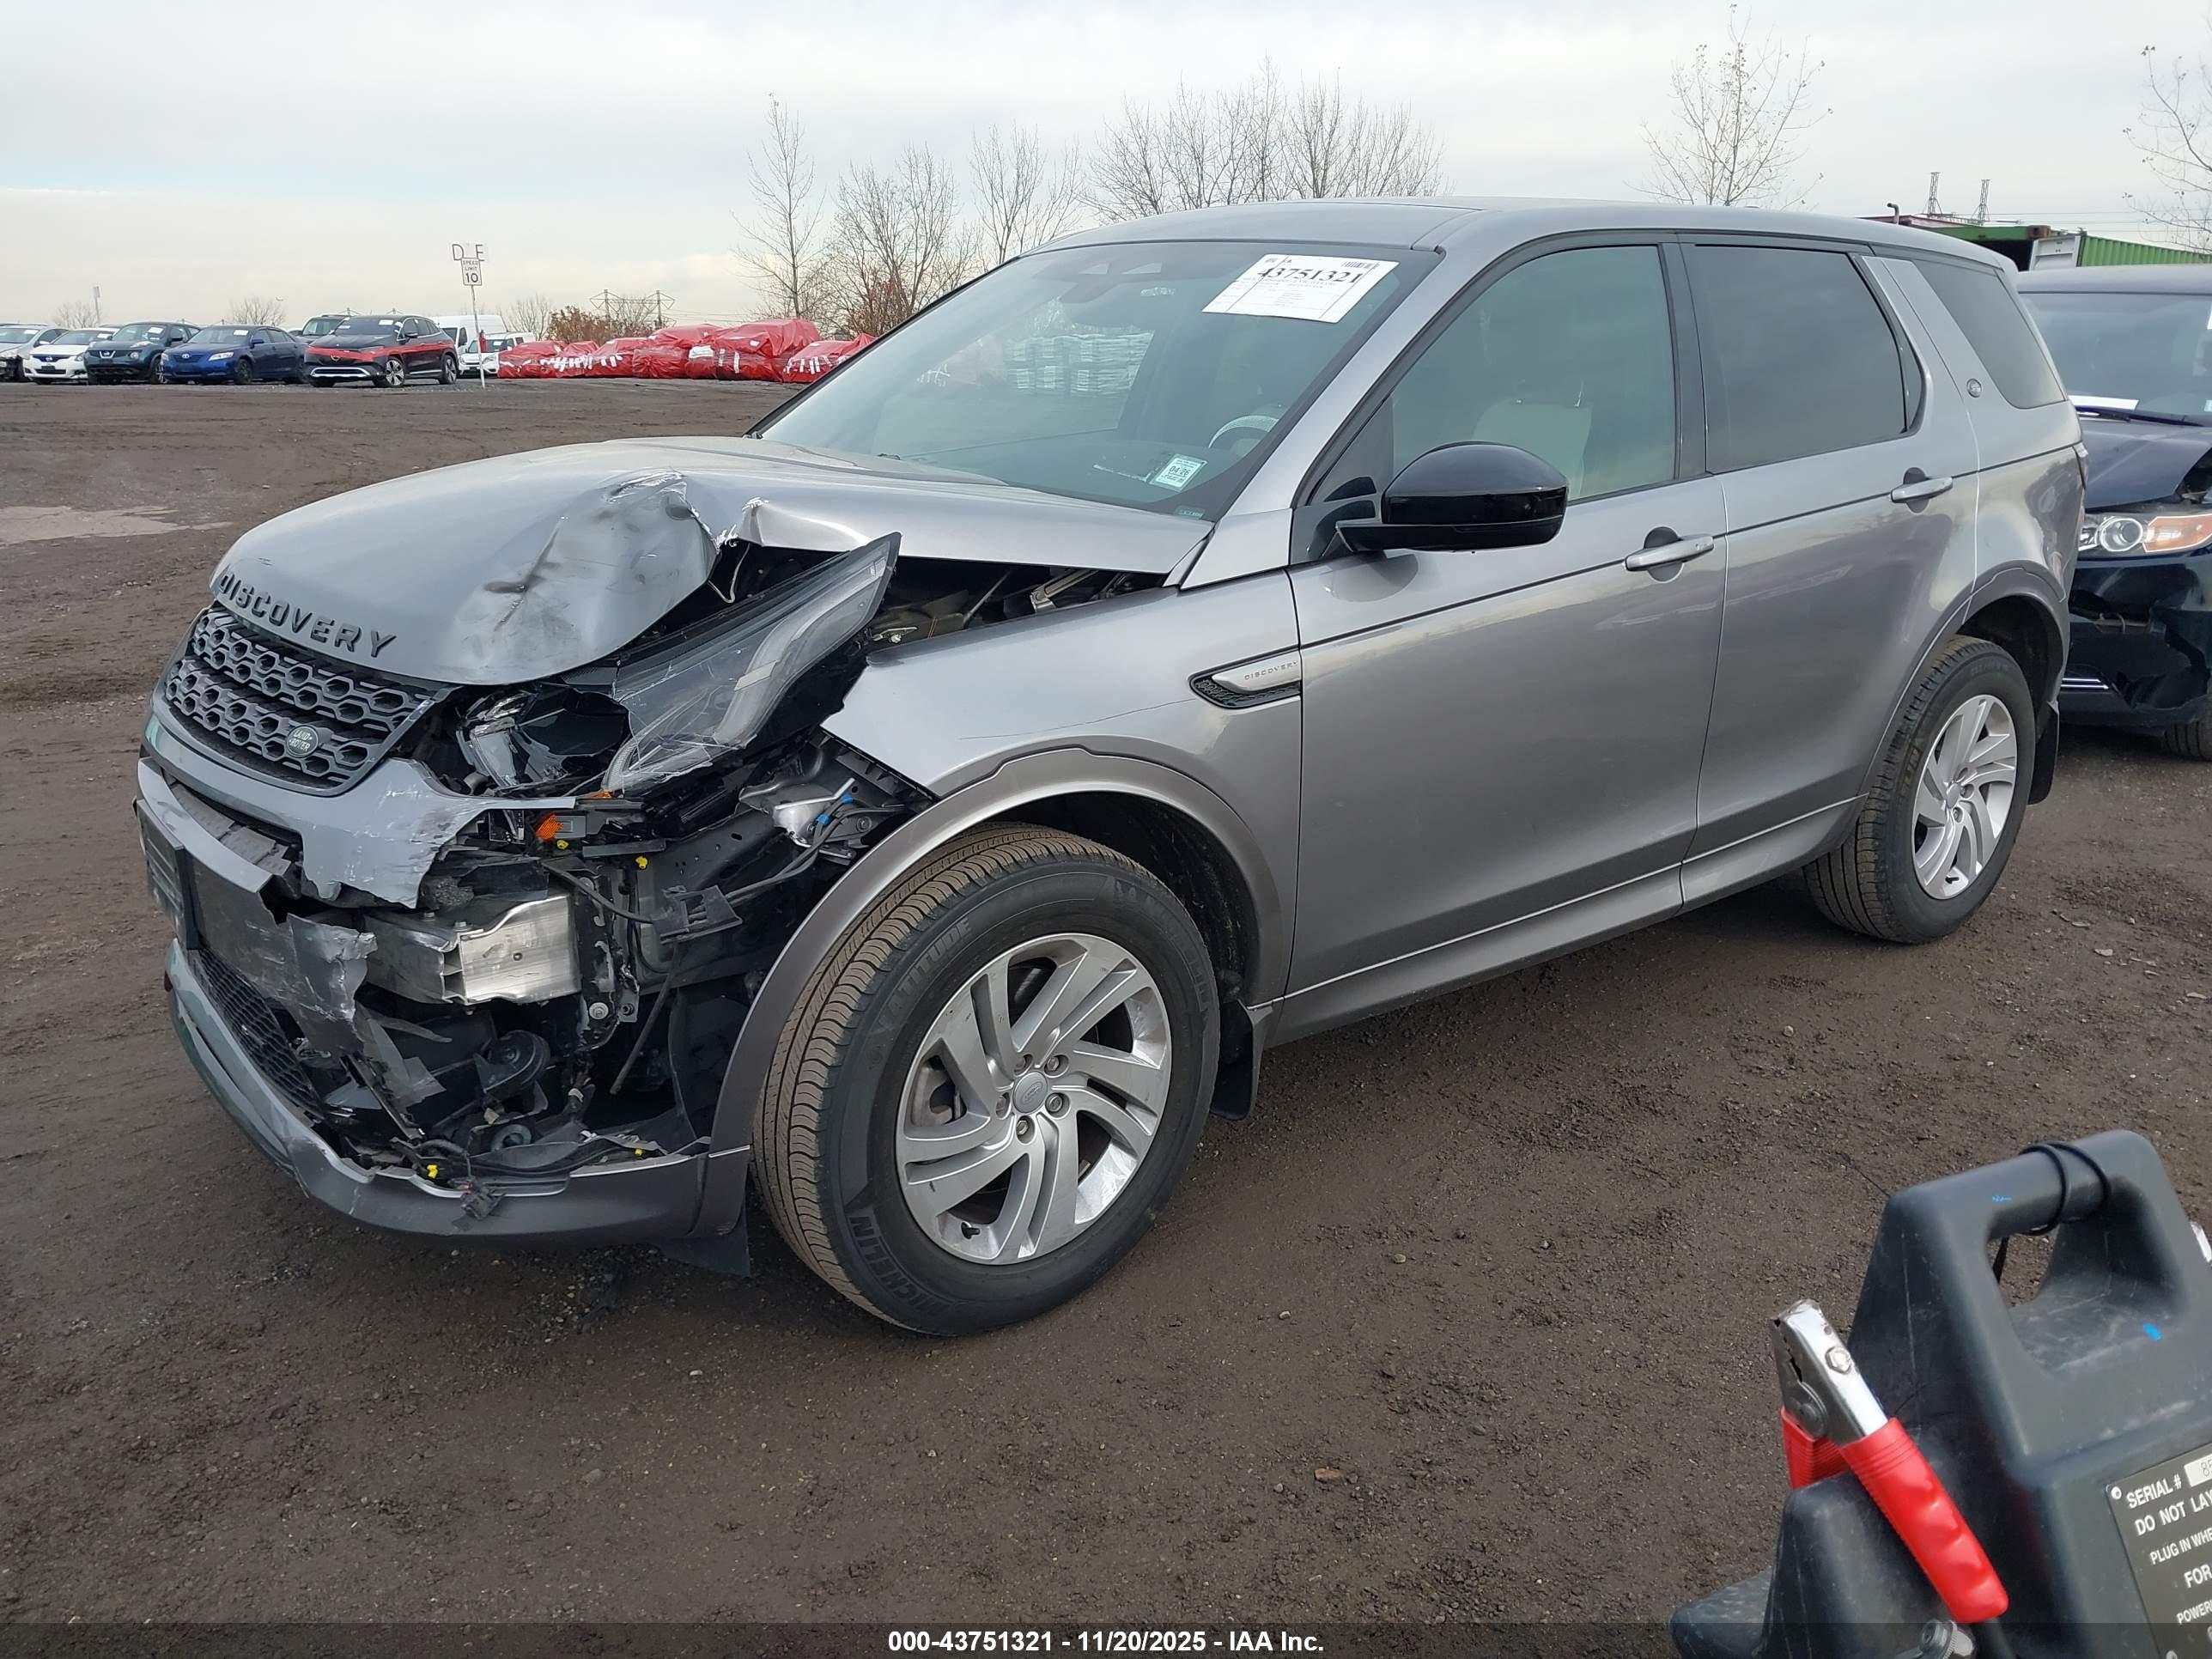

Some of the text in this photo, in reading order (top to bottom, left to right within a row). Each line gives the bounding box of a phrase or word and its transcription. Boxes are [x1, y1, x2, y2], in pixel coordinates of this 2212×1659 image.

[465, 272, 479, 283] 10
[1257, 267, 1364, 283] 43751321
[217, 571, 398, 659] DISCOVERY
[1244, 660, 1298, 681] DISCOVERY
[848, 1215, 949, 1318] MICHELIN
[2125, 1477, 2174, 1510] SERIAL
[2172, 1473, 2182, 1490] #
[2134, 1514, 2156, 1535] DO
[2158, 1500, 2186, 1525] NOT
[2149, 1542, 2180, 1565] PLUG
[2179, 1537, 2192, 1553] IN
[2184, 1564, 2212, 1589] FOR
